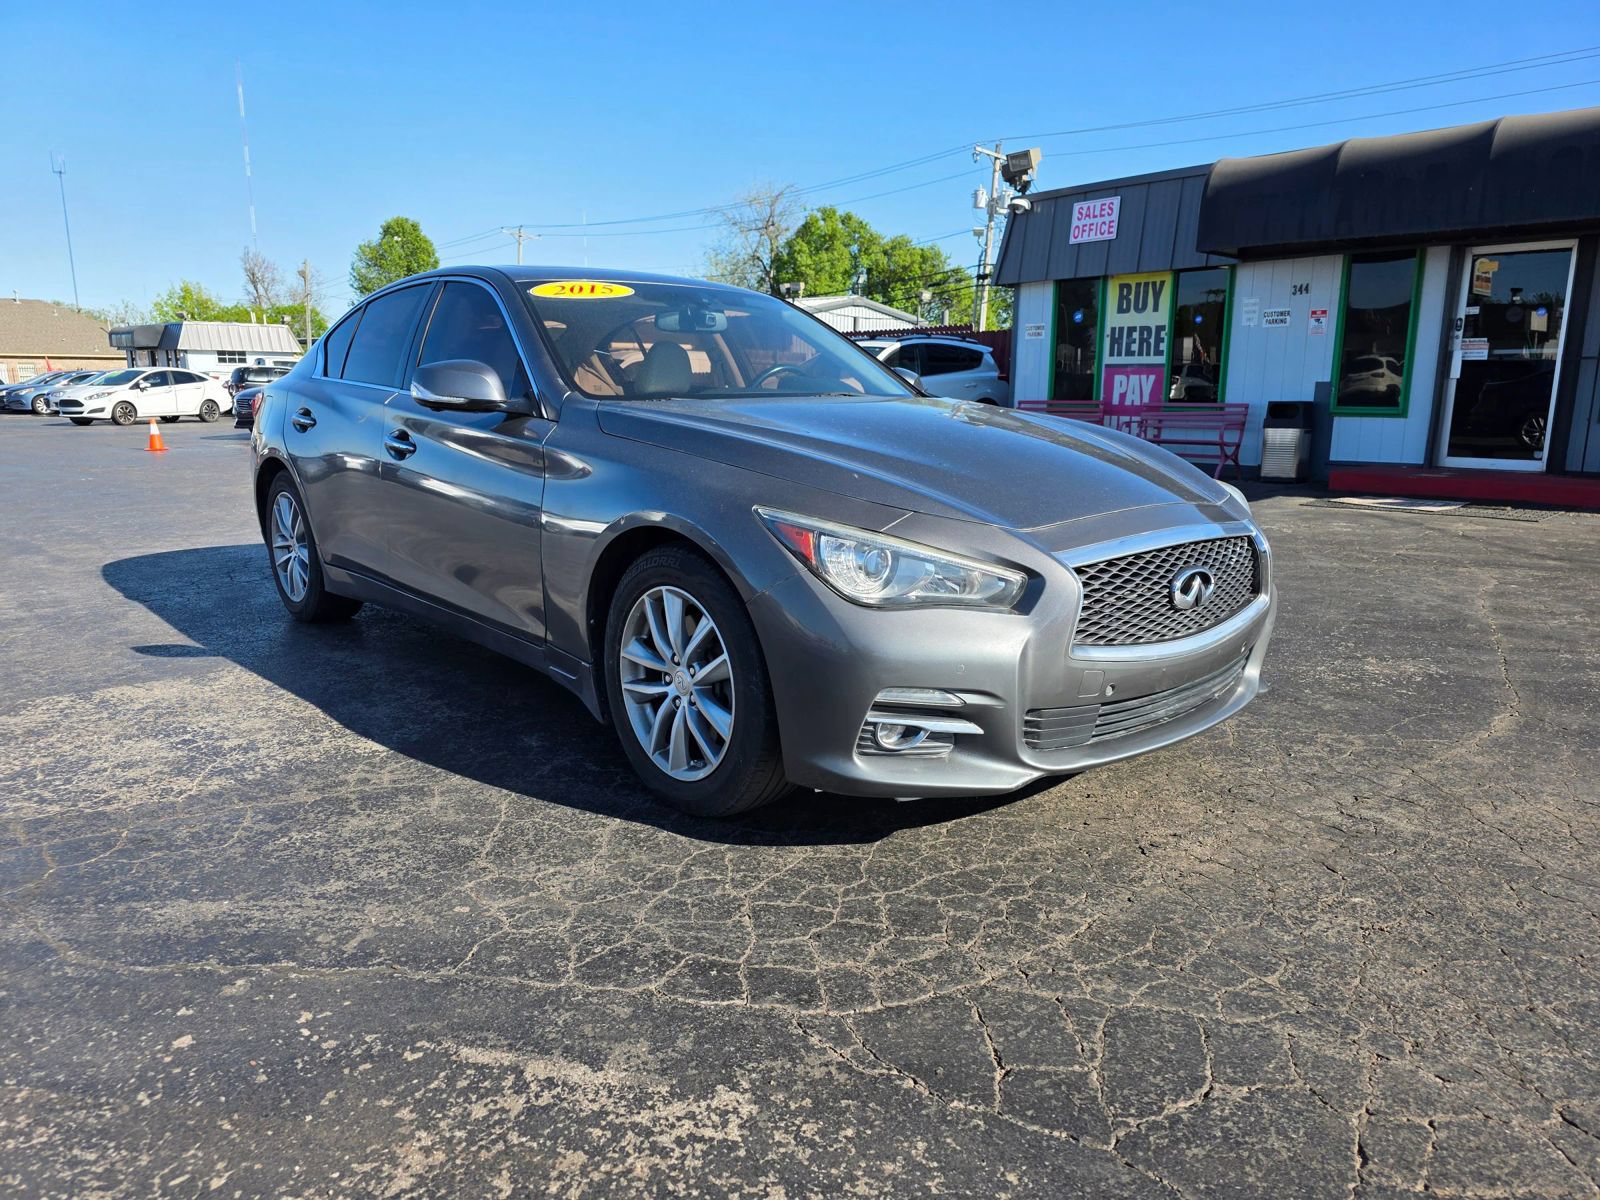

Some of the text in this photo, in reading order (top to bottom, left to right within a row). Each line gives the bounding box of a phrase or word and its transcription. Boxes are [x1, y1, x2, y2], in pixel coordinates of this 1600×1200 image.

[1077, 201, 1114, 222] SALES
[1072, 220, 1115, 239] OFFICE
[553, 285, 613, 296] 2015
[1117, 280, 1166, 315] BUY
[1291, 283, 1310, 296] 344
[1263, 310, 1291, 318] CUSTOMER
[1109, 326, 1166, 357] HERE
[1112, 375, 1156, 406] PAY
